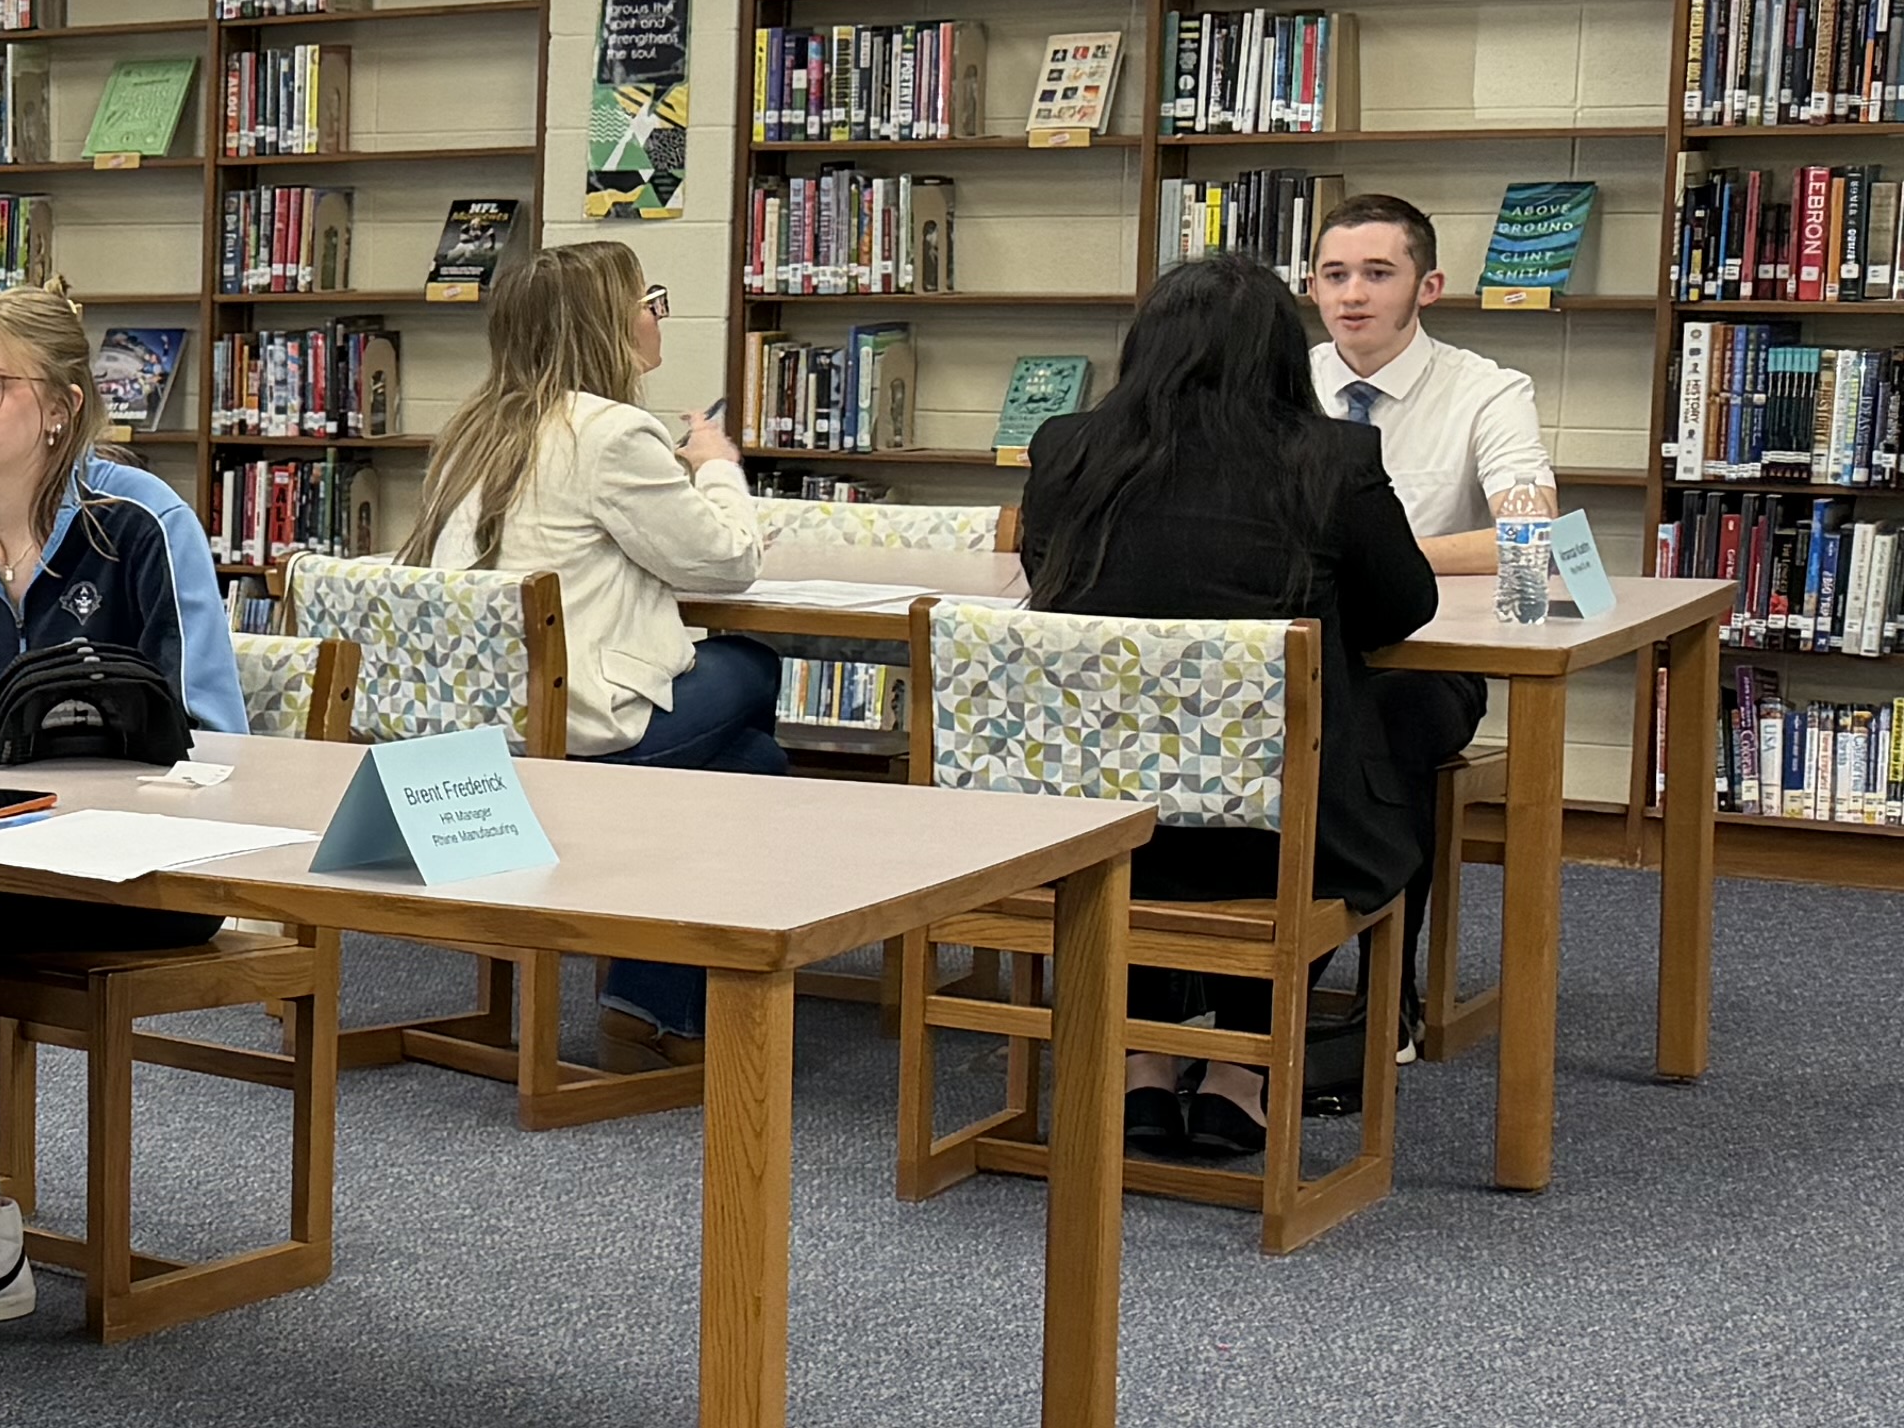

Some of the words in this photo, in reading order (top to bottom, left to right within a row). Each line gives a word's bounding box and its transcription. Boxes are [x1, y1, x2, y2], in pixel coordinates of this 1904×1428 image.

[1512, 203, 1571, 216] ABOVE
[1803, 169, 1825, 255] LEBRON
[1500, 251, 1555, 263] CLINT
[1494, 268, 1549, 280] SMITH
[1858, 396, 1873, 430] IDEAS
[1764, 724, 1777, 753] USA
[404, 785, 442, 805] Brent
[442, 773, 507, 801] Frederick
[439, 810, 454, 825] HR
[455, 807, 492, 824] Manager
[459, 822, 520, 845] Manufacturing
